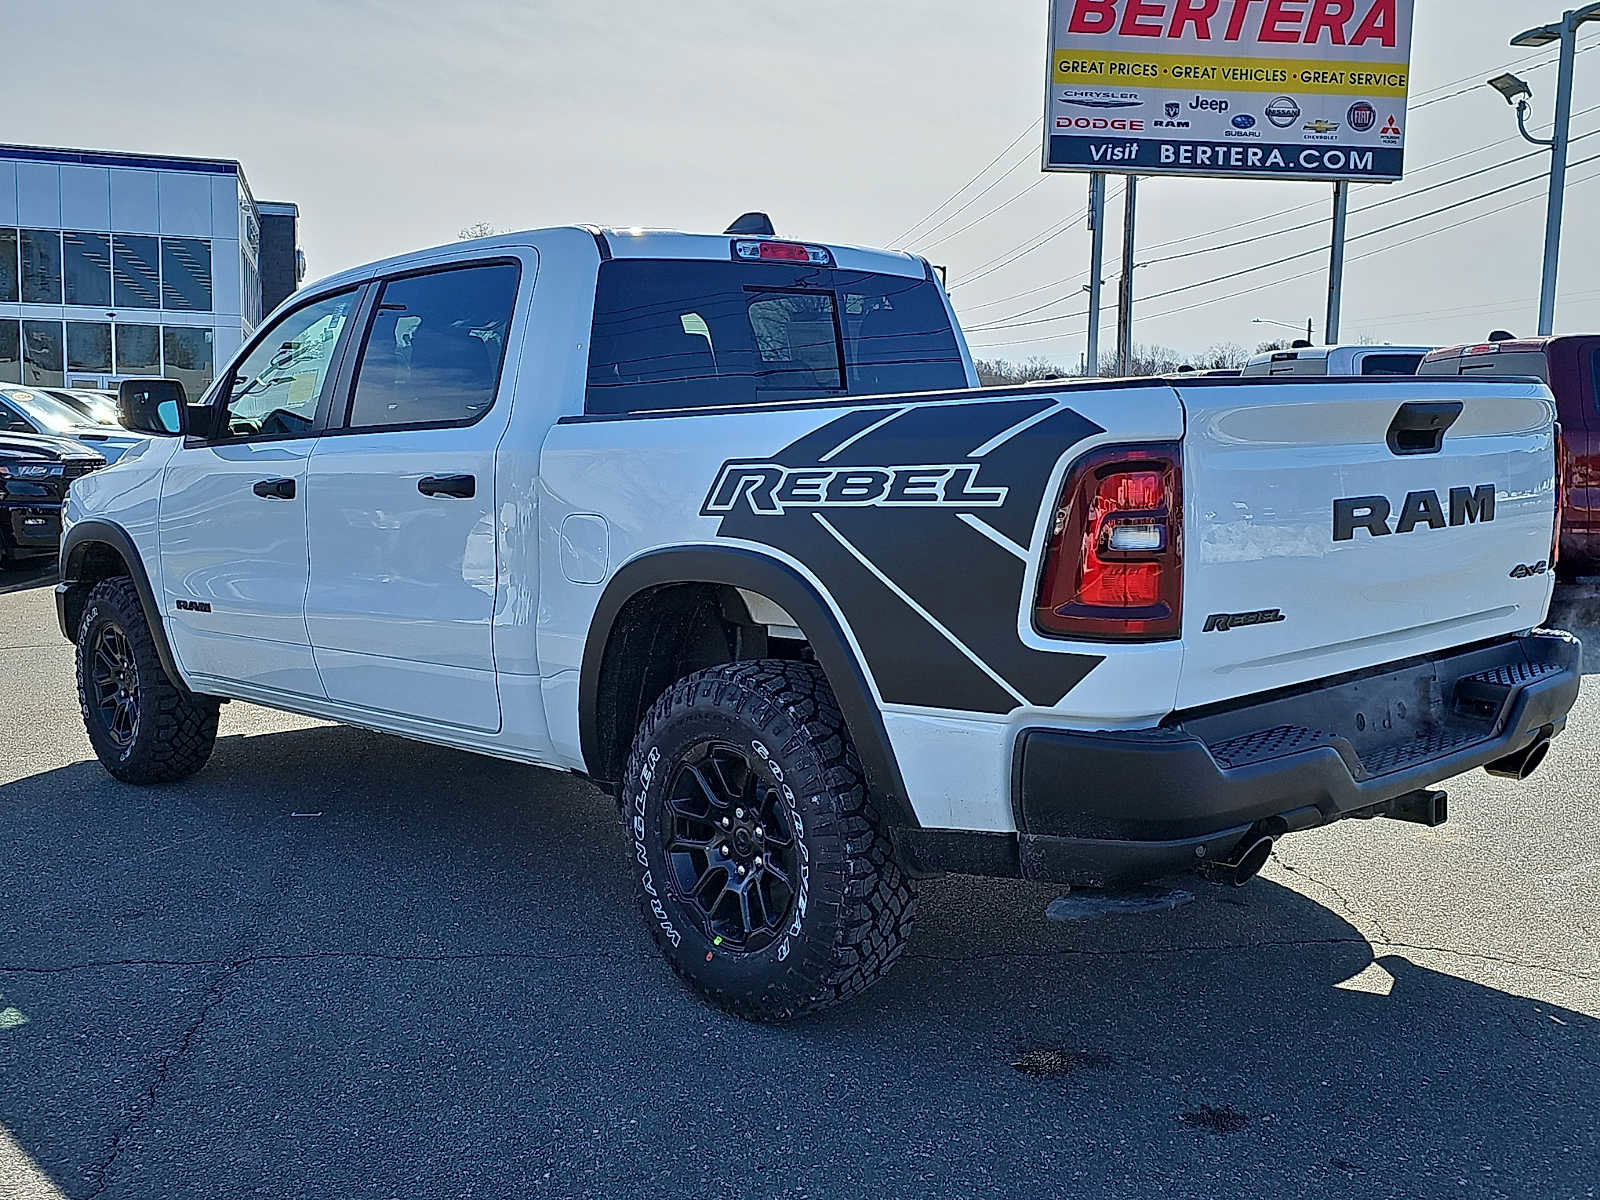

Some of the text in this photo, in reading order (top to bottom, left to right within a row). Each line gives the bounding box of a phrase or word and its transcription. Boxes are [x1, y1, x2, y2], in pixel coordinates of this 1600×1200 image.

[1067, 0, 1397, 48] BERTERA
[1058, 60, 1406, 87] GREAT PRICES GREAT VEHICLES GREAT SERVICE
[1063, 90, 1138, 99] CHRYSLER
[1188, 95, 1229, 114] Jeep
[1056, 117, 1144, 131] DODGE
[1153, 120, 1190, 128] RAM
[1267, 107, 1299, 117] NISSAN
[1354, 110, 1371, 124] FIAT
[1224, 130, 1261, 138] SUBARU
[1090, 142, 1374, 171] Visit BERTERA.COM
[706, 463, 1009, 516] REBEL
[1332, 483, 1497, 542] RAM
[1202, 608, 1286, 633] REBEL
[633, 746, 682, 948] WRANGLER
[751, 740, 809, 961] GOODYEAR
